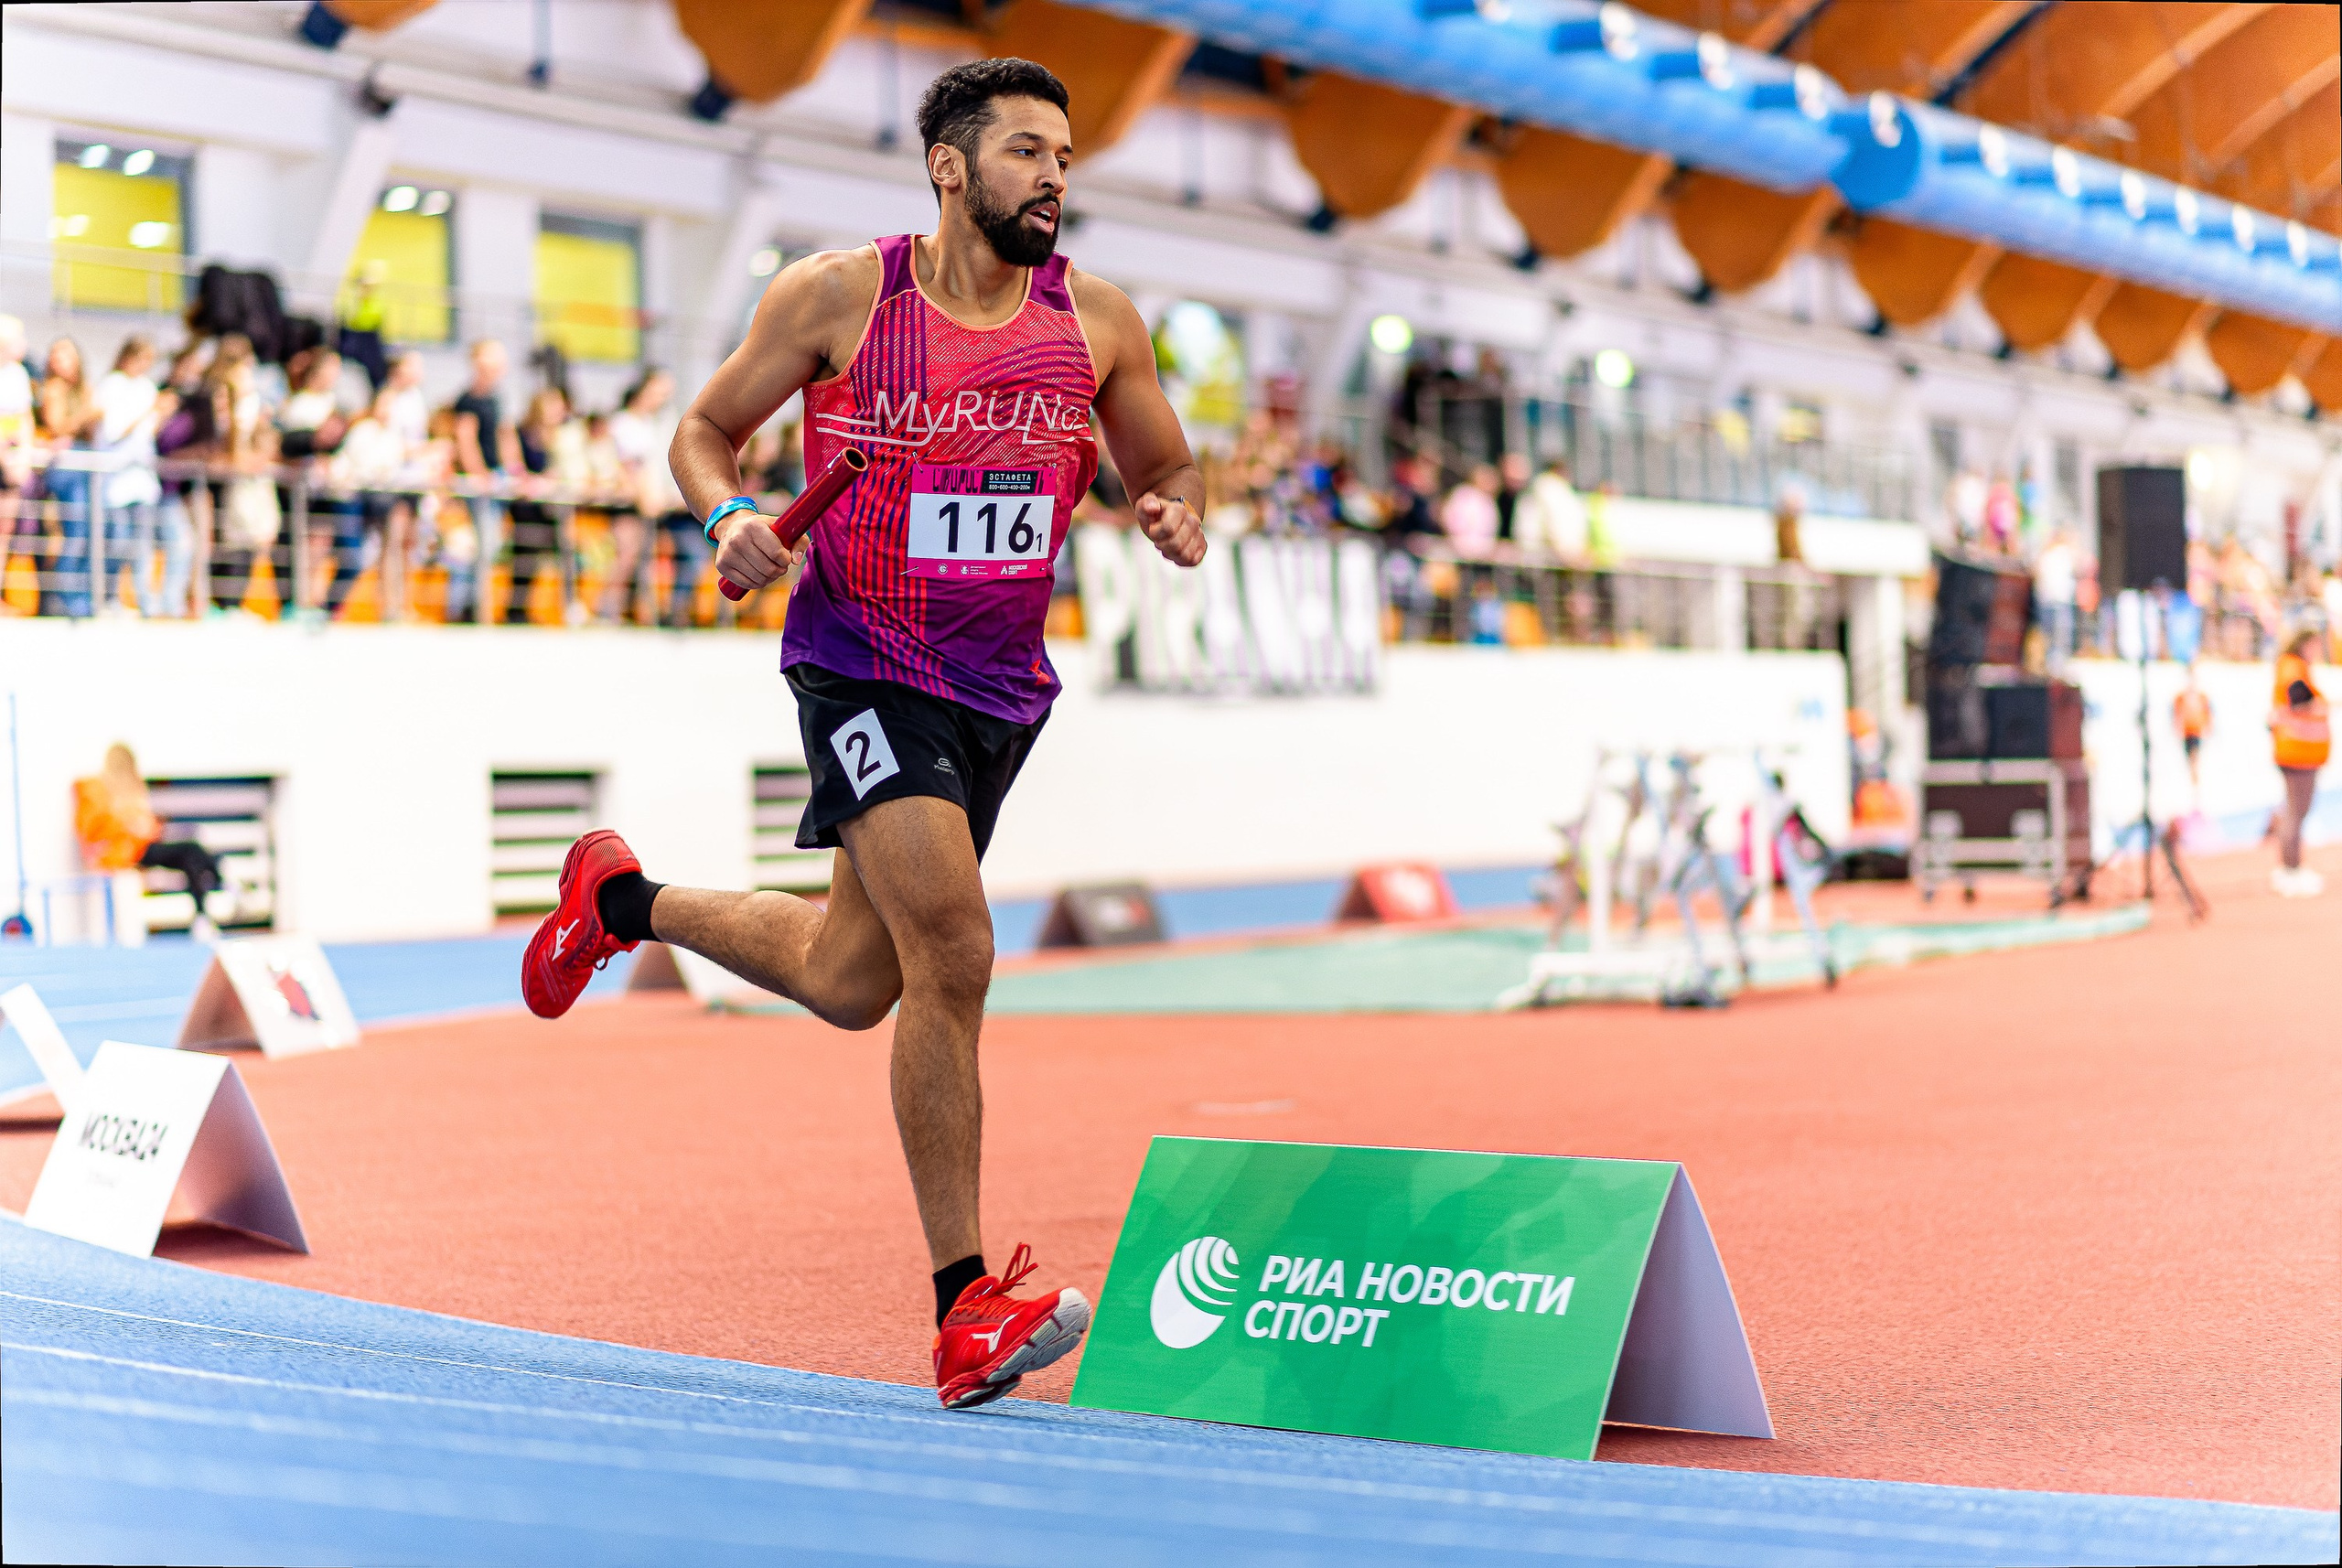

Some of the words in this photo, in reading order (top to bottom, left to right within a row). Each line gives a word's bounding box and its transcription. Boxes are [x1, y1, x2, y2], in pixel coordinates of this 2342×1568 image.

[989, 473, 1031, 481] ЭСТАФЕТА
[939, 501, 1034, 553] 116
[845, 731, 882, 782] 2
[1259, 1254, 1345, 1298] РИА
[1355, 1262, 1576, 1316] НОВОСТИ
[1245, 1299, 1391, 1348] СПОРТ
